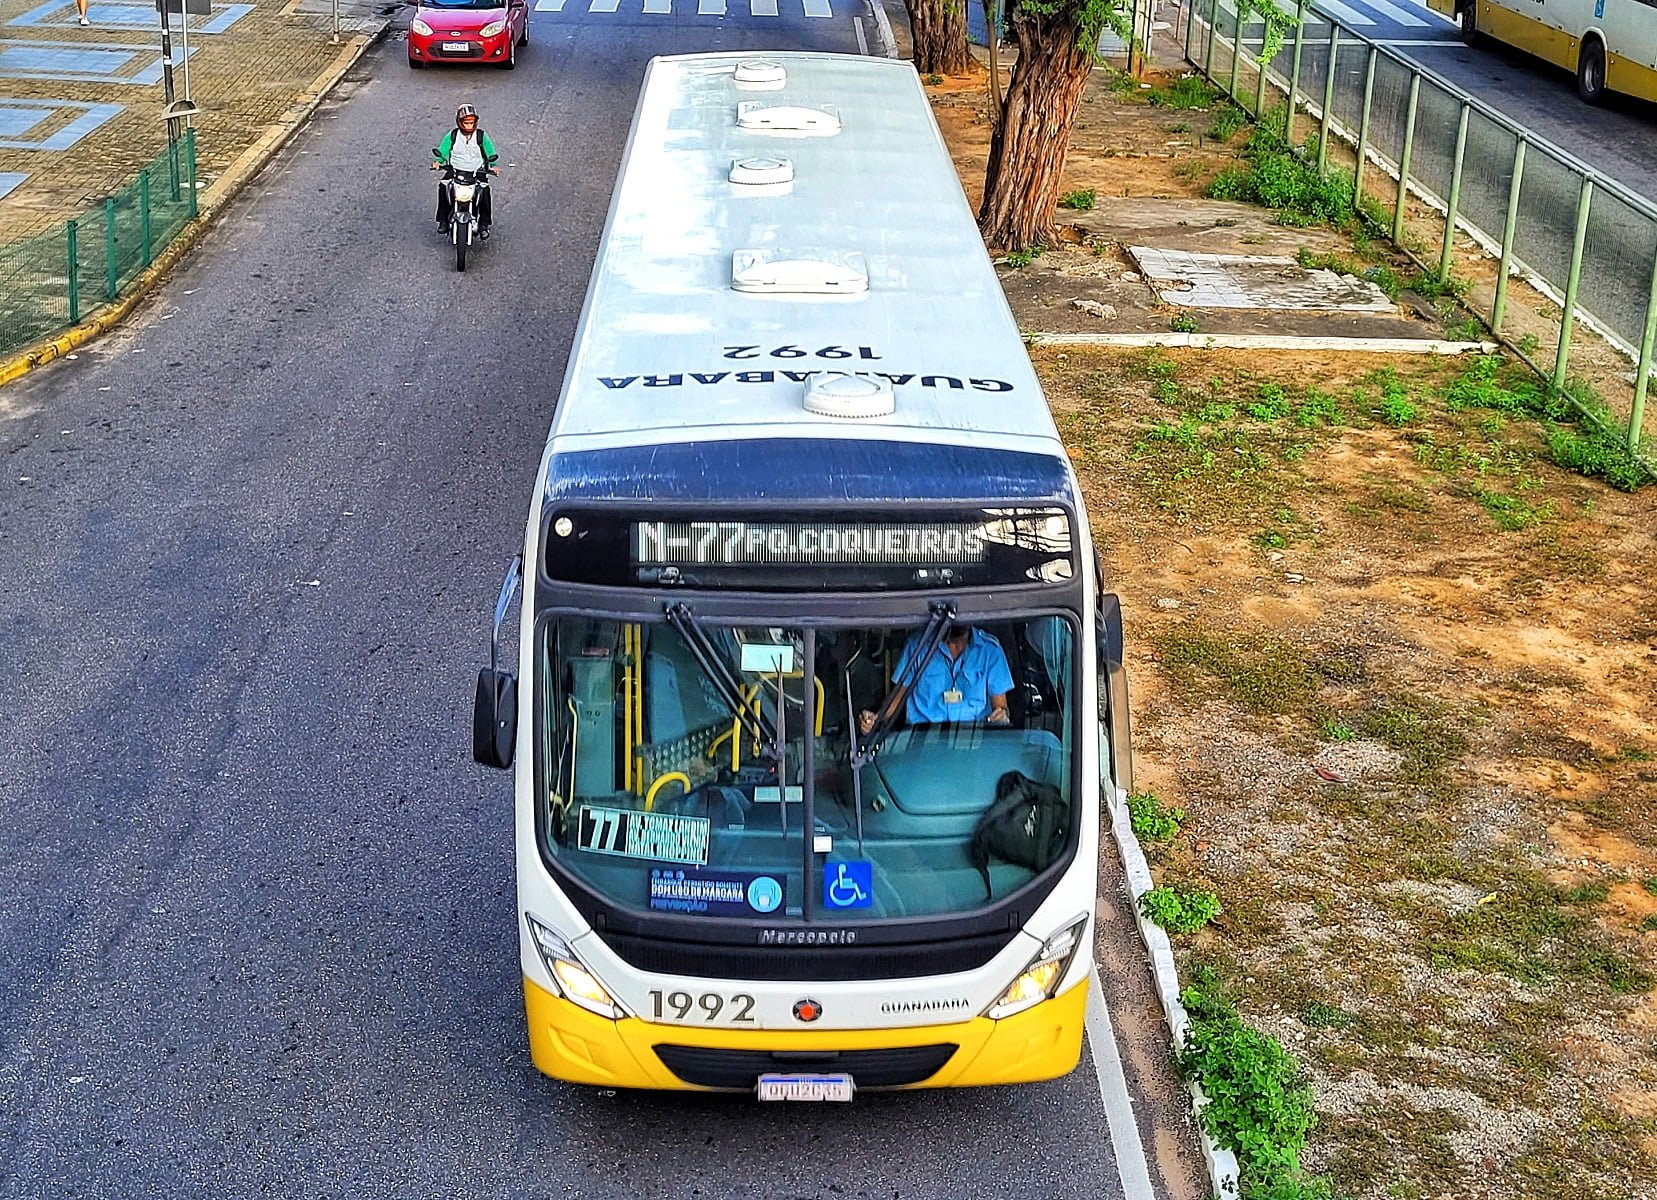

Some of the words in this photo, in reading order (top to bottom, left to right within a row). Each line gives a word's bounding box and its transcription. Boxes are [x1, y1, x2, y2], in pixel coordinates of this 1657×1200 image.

[723, 345, 882, 359] 1992
[597, 370, 1014, 392] GUAABARA
[638, 521, 744, 562] N-77
[746, 528, 983, 554] PQ.COQUEIROS
[589, 809, 620, 851] 77
[649, 990, 755, 1022] 1992
[881, 999, 969, 1013] GUANABARA
